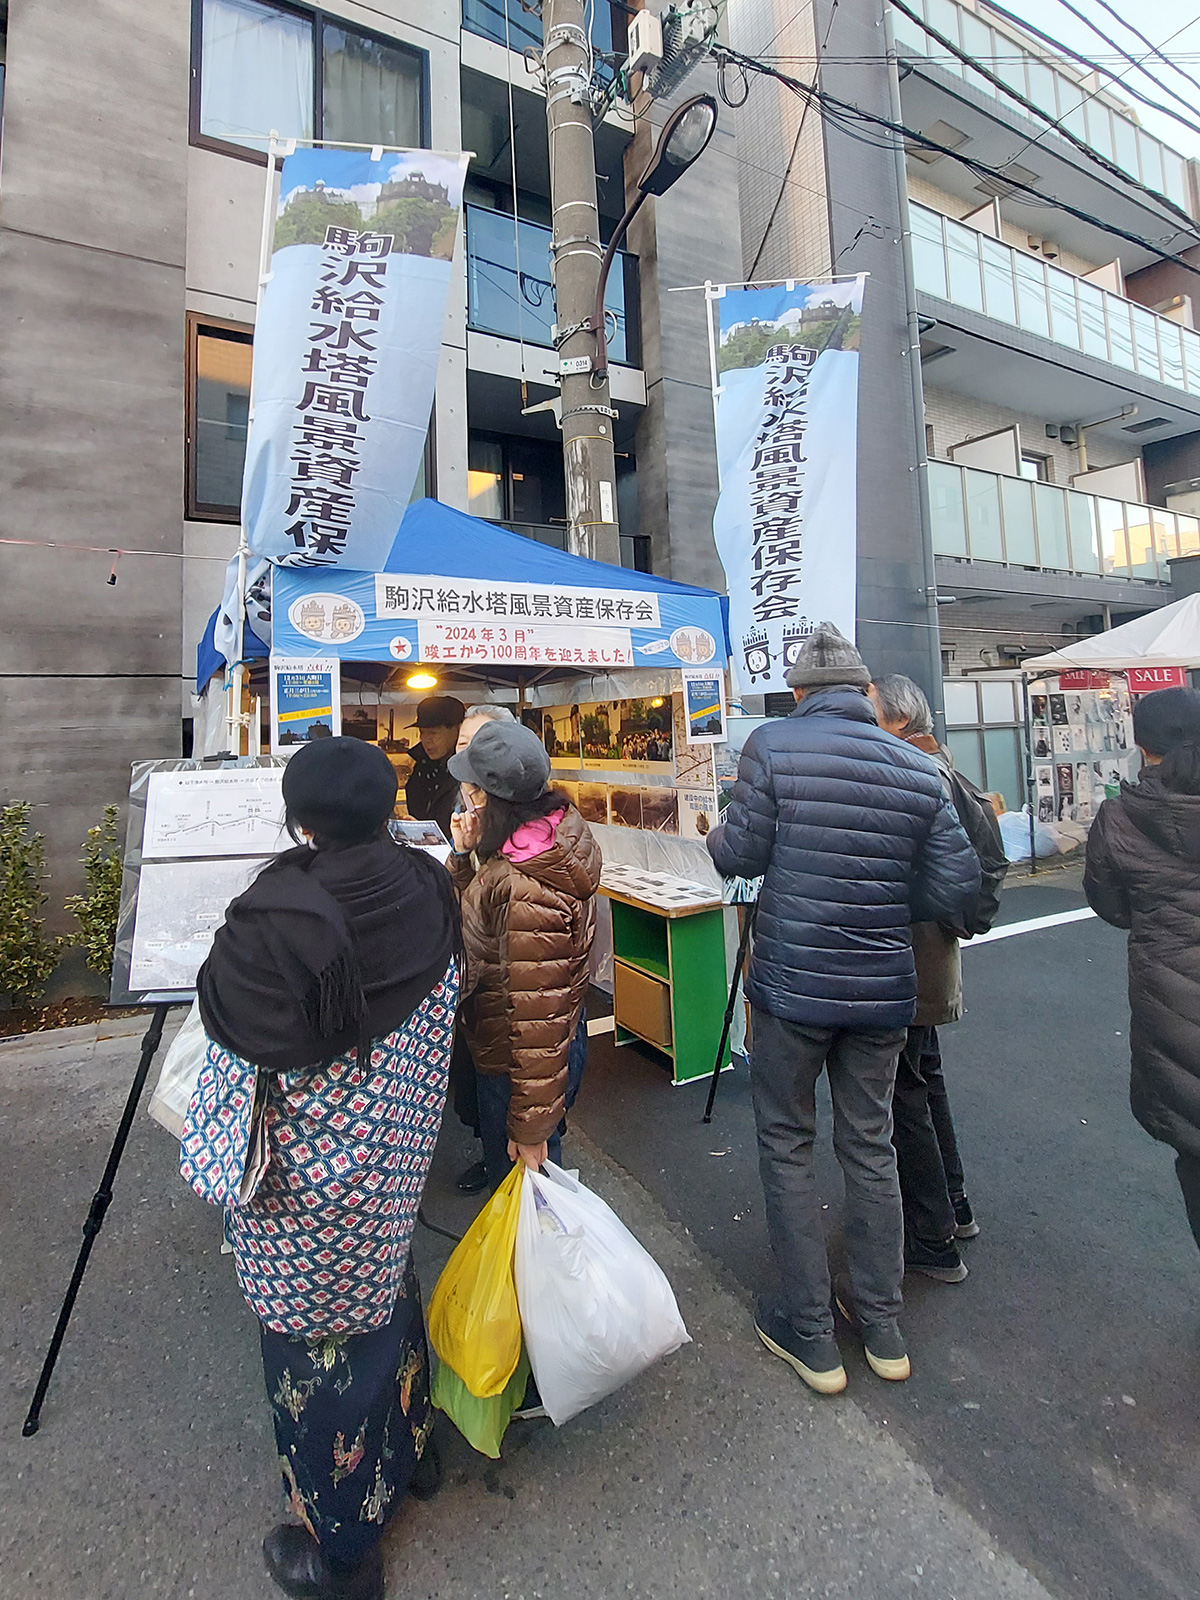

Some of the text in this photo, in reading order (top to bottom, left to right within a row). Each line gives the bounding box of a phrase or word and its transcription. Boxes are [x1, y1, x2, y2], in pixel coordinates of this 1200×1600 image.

[749, 343, 819, 622] 駒沢給水塔風景資産保存会
[384, 585, 653, 622] 駒沢給水塔風景資産保存会
[1135, 669, 1173, 682] SALE
